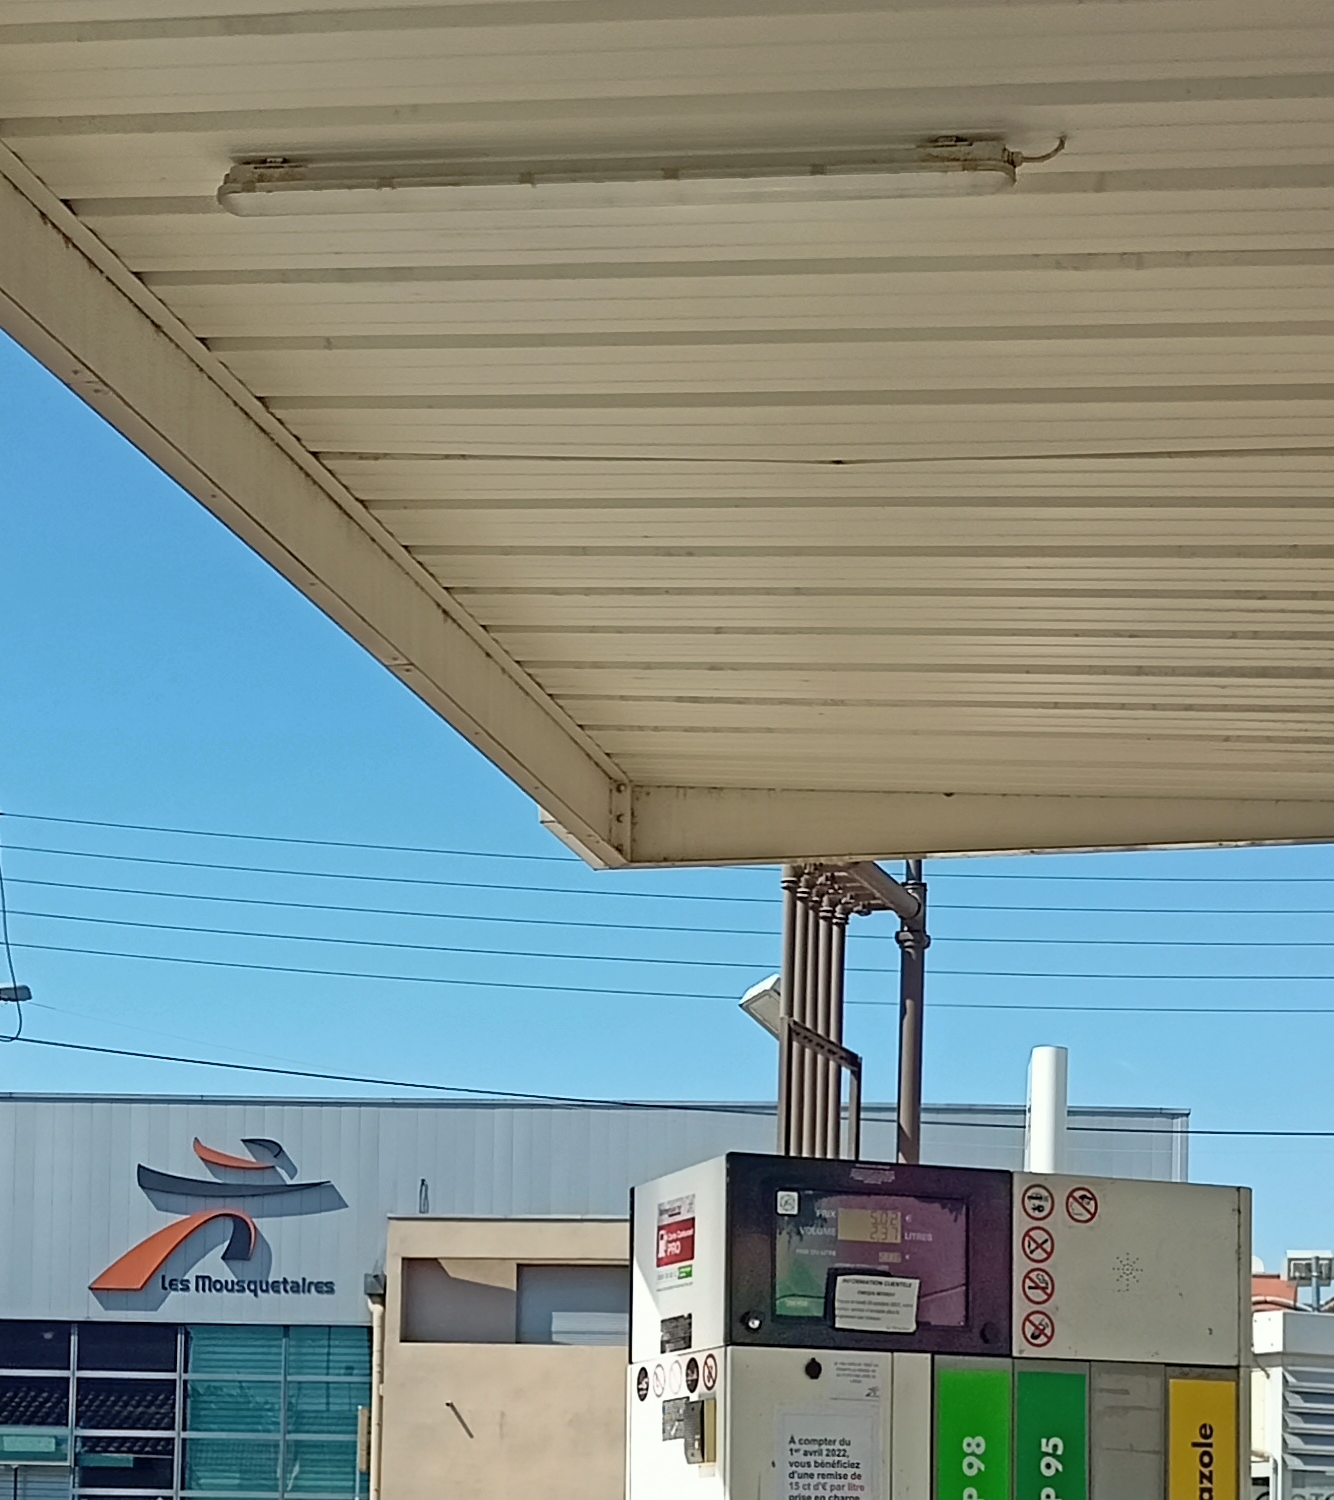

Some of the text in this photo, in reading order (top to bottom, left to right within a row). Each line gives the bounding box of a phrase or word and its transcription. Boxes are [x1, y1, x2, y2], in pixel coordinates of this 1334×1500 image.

[815, 1208, 837, 1219] PRIX
[798, 1225, 837, 1237] VOLUME
[904, 1231, 934, 1242] LITRES
[666, 1240, 682, 1257] PRO
[195, 1274, 336, 1299] Mousquetaires
[798, 1438, 836, 1447] compter
[838, 1437, 850, 1446] du
[802, 1448, 824, 1456] avril
[961, 1435, 987, 1477] 98
[1039, 1436, 1065, 1477] 95
[788, 1460, 860, 1469] vous bénéficiez
[788, 1471, 862, 1480] d'une remise de
[788, 1481, 800, 1490] 15
[802, 1482, 812, 1491] ct
[830, 1484, 846, 1493] par
[846, 1482, 866, 1492] litre
